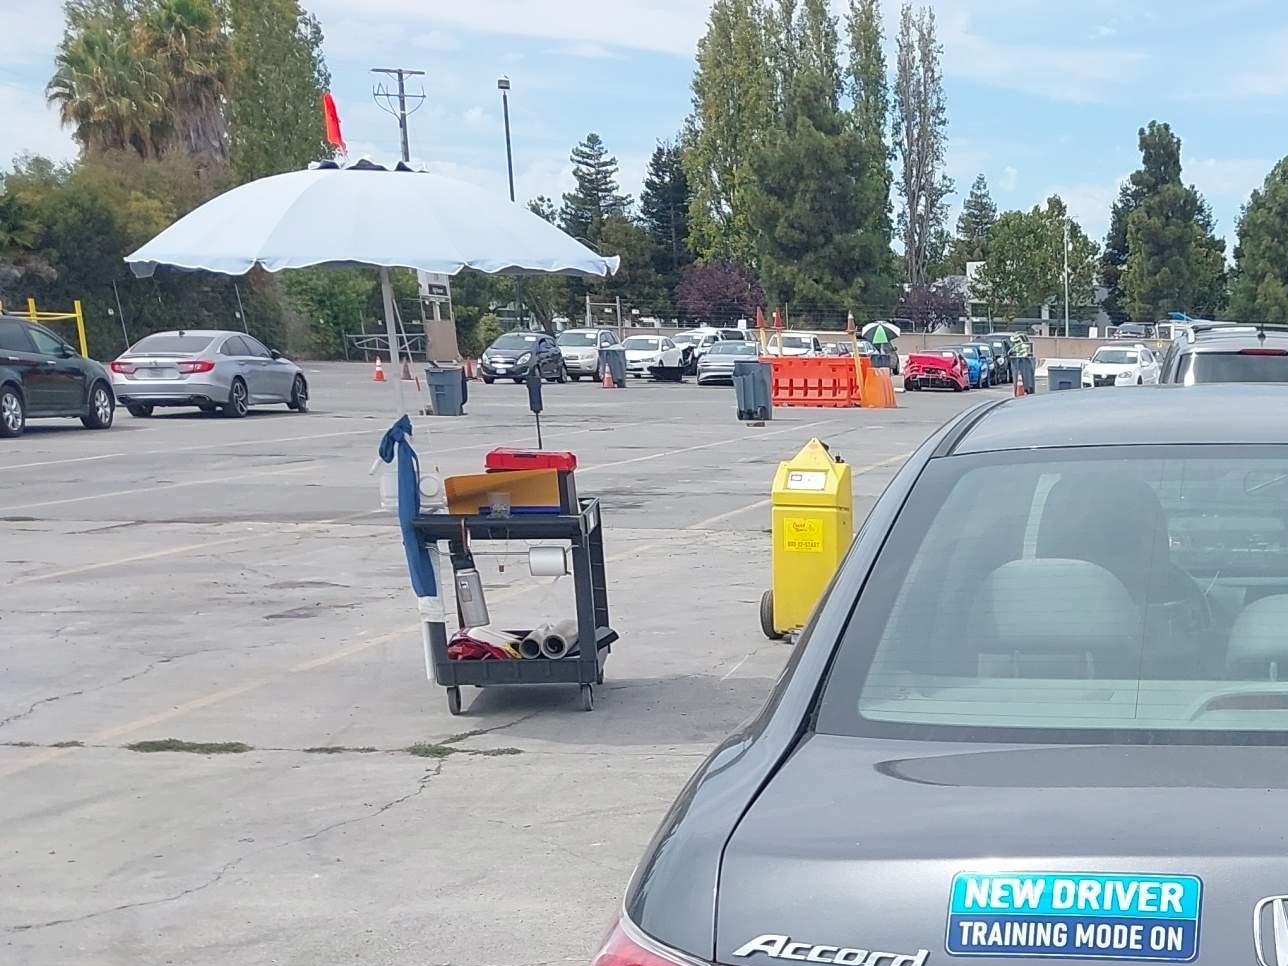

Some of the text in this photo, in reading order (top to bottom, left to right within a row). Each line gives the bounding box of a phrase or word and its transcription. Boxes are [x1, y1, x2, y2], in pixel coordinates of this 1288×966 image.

[964, 878, 1185, 913] NEW DRIVER
[959, 921, 1184, 951] TRAINING MODE ON
